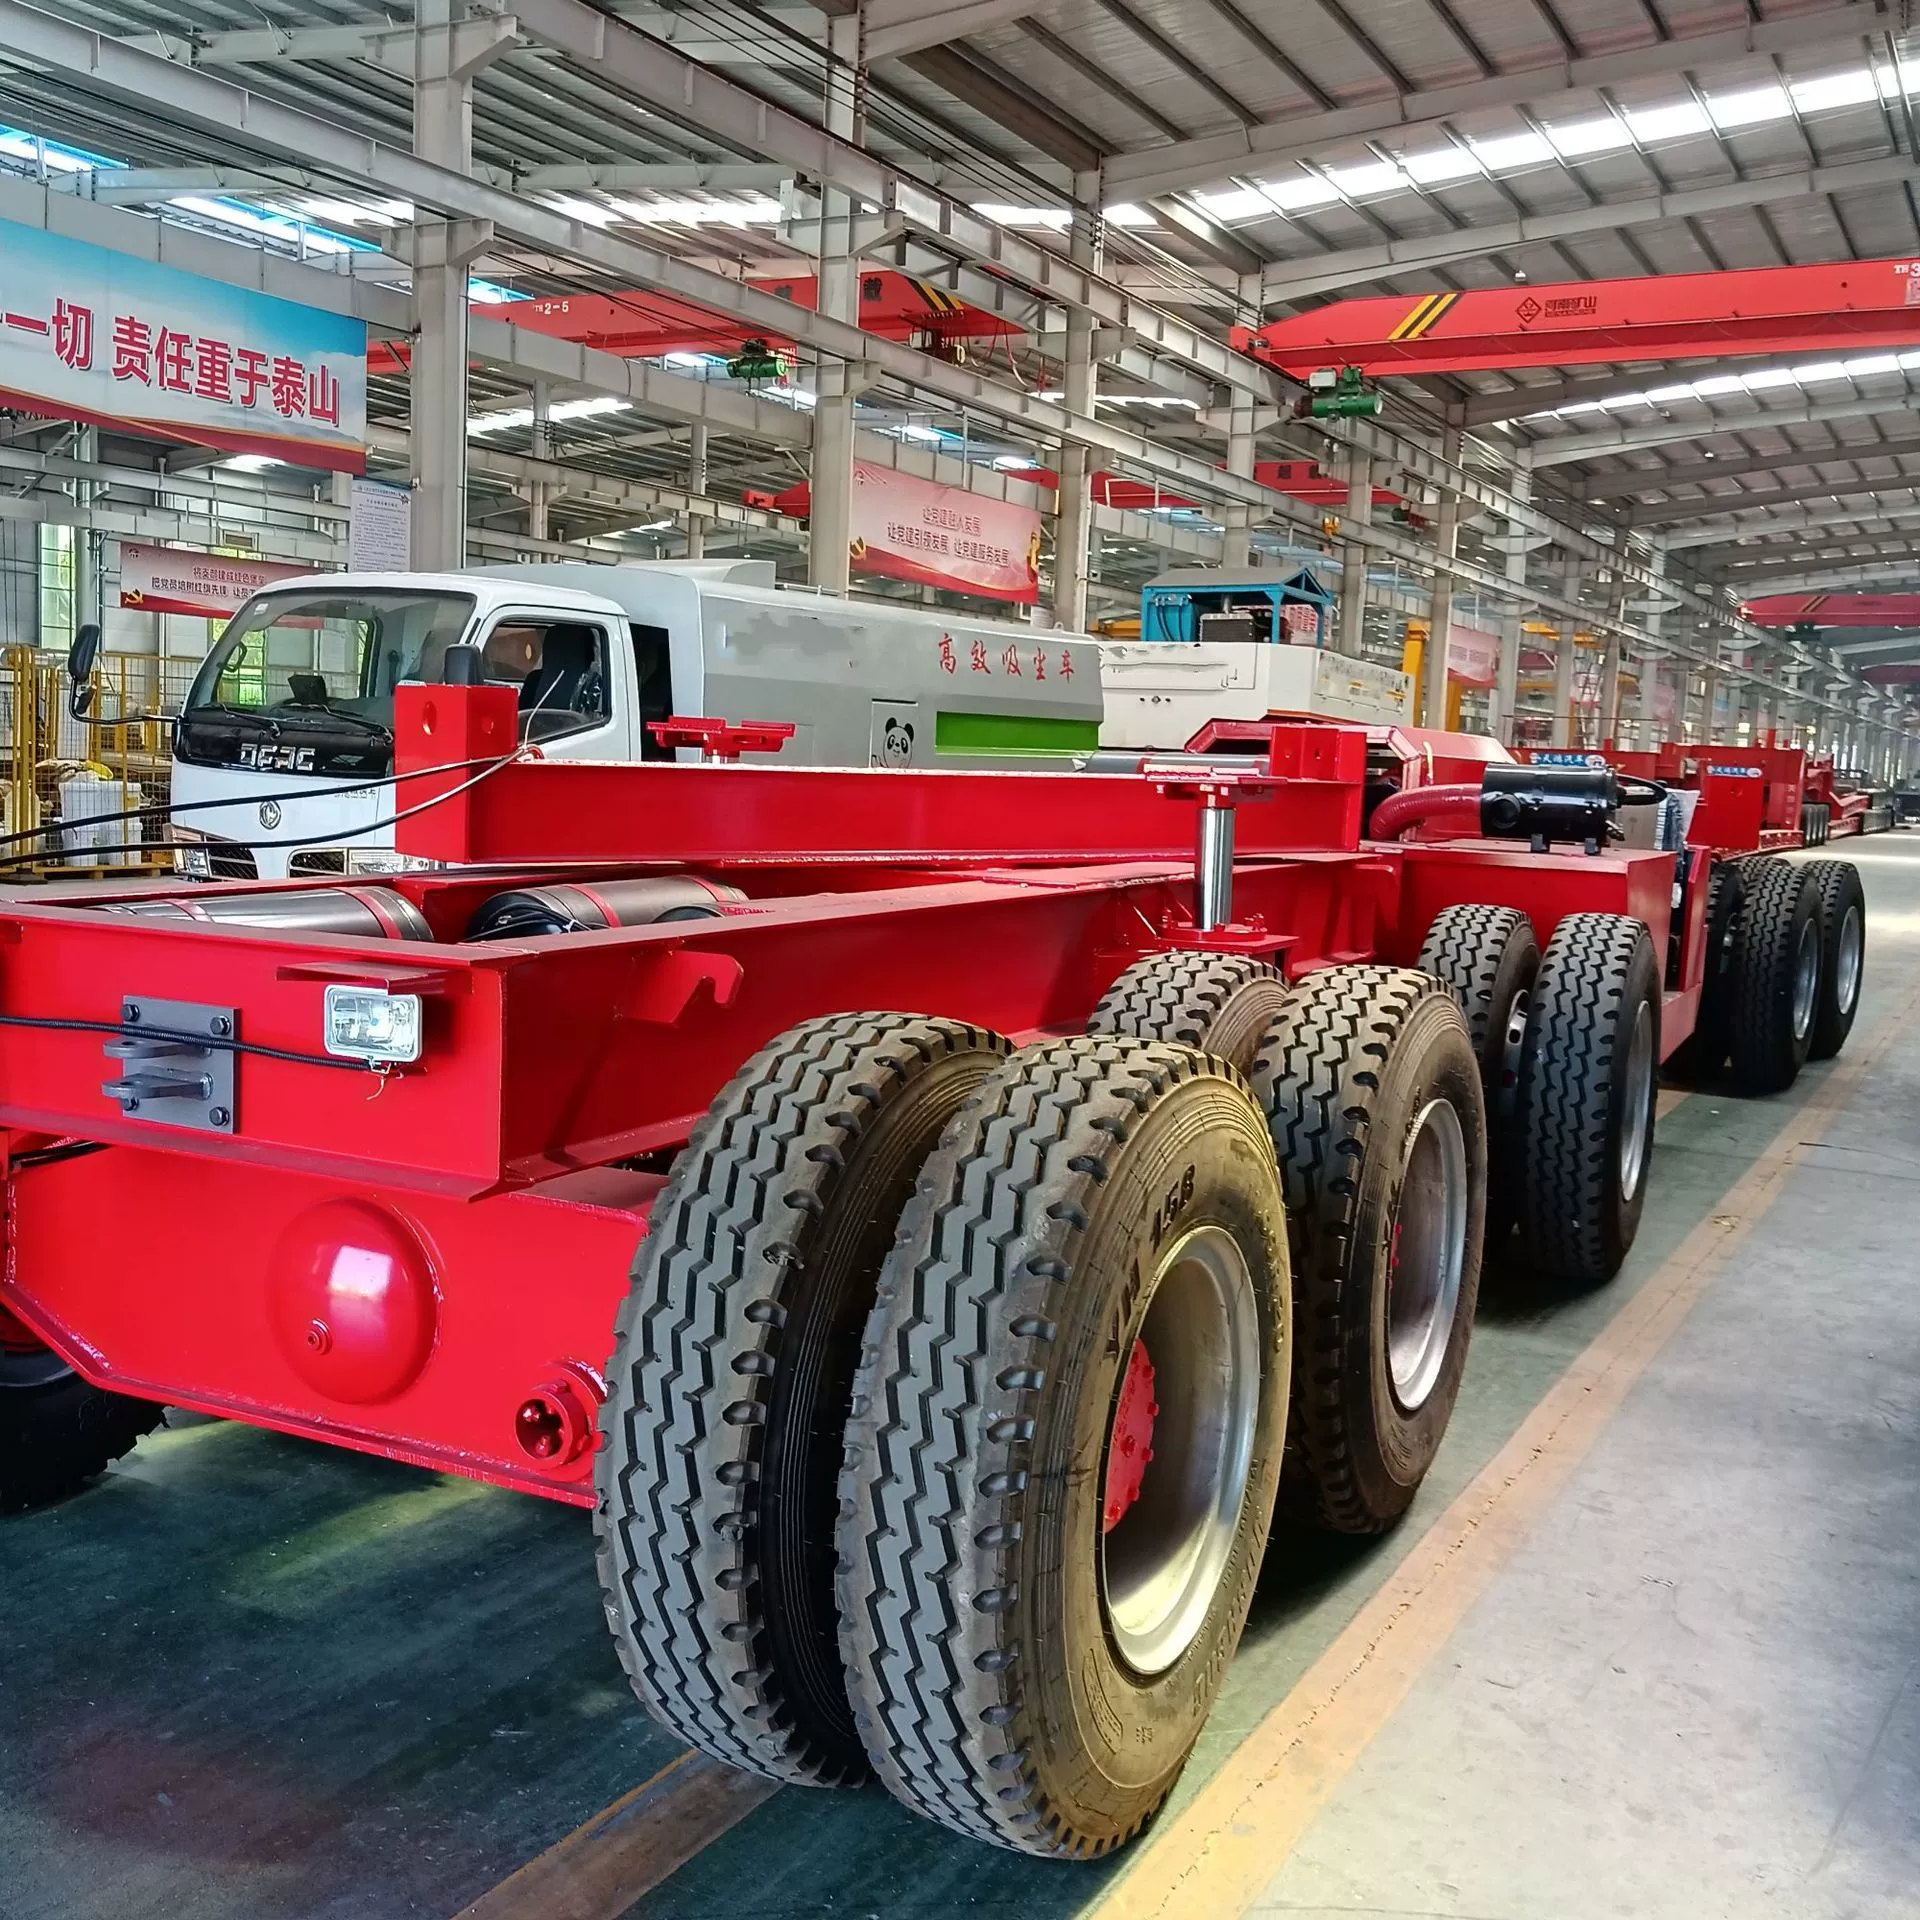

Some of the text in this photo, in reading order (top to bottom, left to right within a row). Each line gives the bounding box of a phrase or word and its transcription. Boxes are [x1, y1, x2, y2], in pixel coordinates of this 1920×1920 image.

[112, 315, 341, 427] 责任重于泰山
[938, 632, 1075, 684] 高效吸尘车
